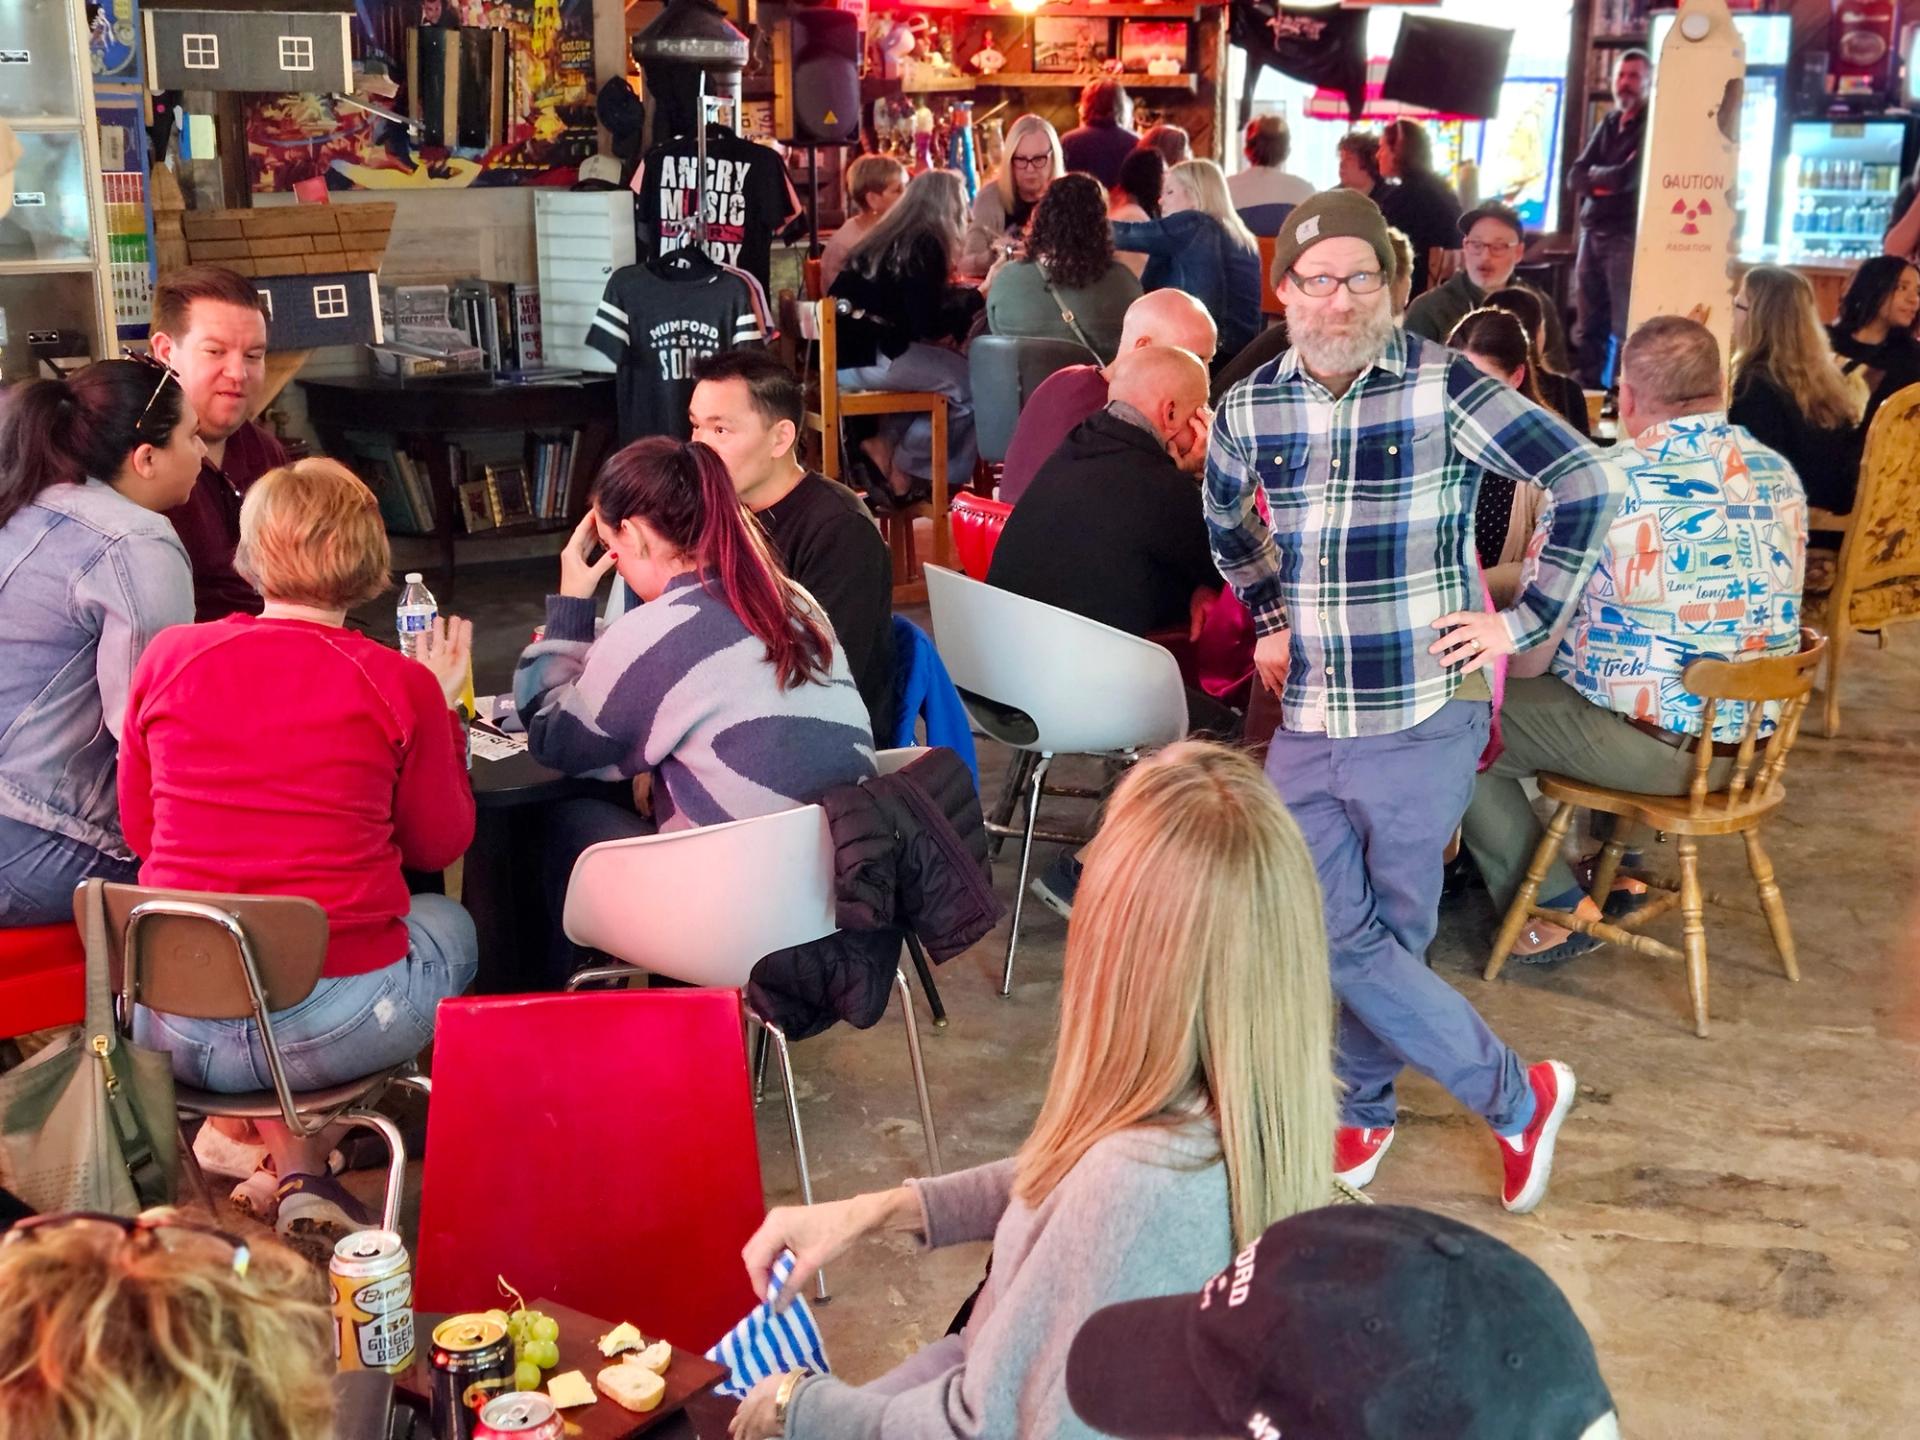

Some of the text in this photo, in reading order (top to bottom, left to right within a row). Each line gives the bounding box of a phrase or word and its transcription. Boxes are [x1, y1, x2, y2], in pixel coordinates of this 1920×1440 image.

[656, 39, 707, 54] Peter
[660, 155, 752, 193] ANGRY
[1662, 173, 1725, 190] CAUTION
[660, 188, 746, 226] MUSIC
[1665, 242, 1713, 253] RADIATION
[649, 319, 719, 340] MUMFORD
[679, 334, 690, 347] &
[1601, 657, 1648, 678] trek
[1228, 1236, 1262, 1308] ORD
[368, 1324, 413, 1352] GINGER
[377, 1340, 410, 1362] BEER
